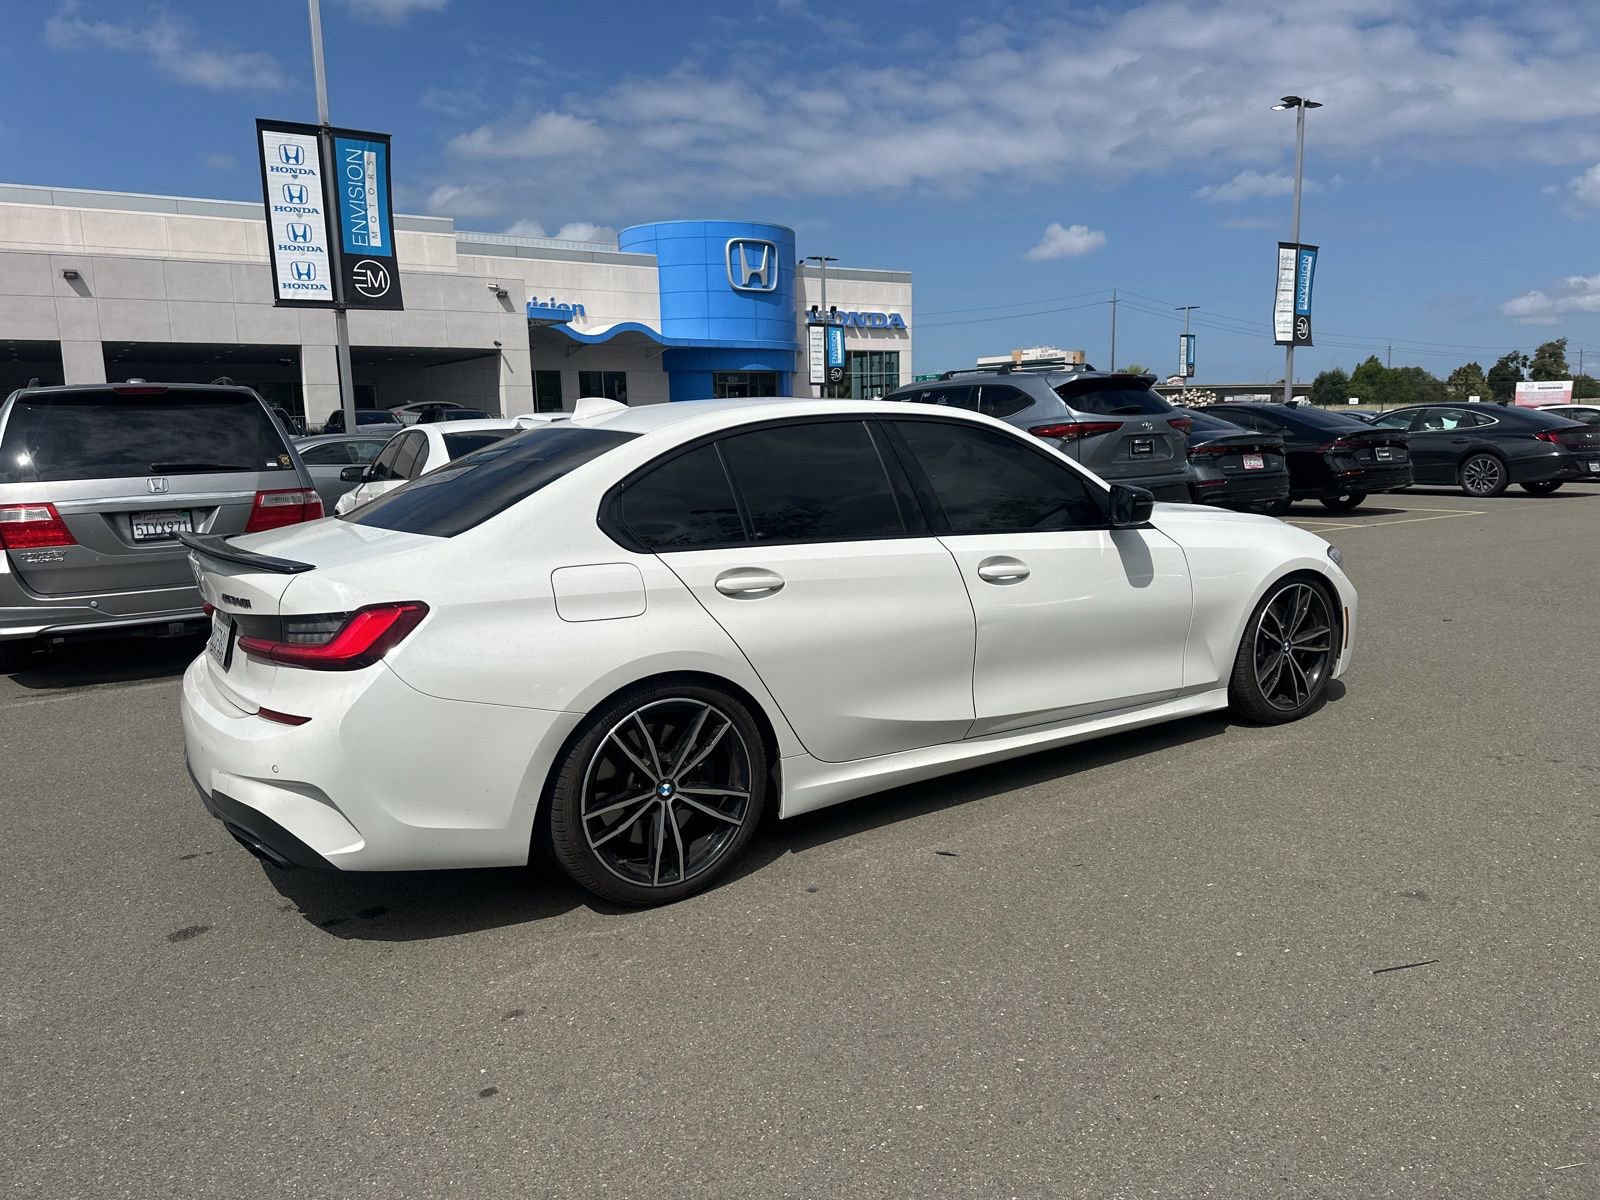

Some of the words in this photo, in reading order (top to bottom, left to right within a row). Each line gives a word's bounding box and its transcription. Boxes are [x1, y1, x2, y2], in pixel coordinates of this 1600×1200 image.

[270, 165, 316, 176] HONDA
[345, 148, 368, 247] ENVISION
[367, 159, 379, 239] MOTORS
[274, 205, 320, 215] HONDA
[278, 244, 324, 253] HONDA
[282, 282, 328, 291] HONDA
[1298, 255, 1309, 310] ENVISION
[831, 329, 839, 364] ENVISION
